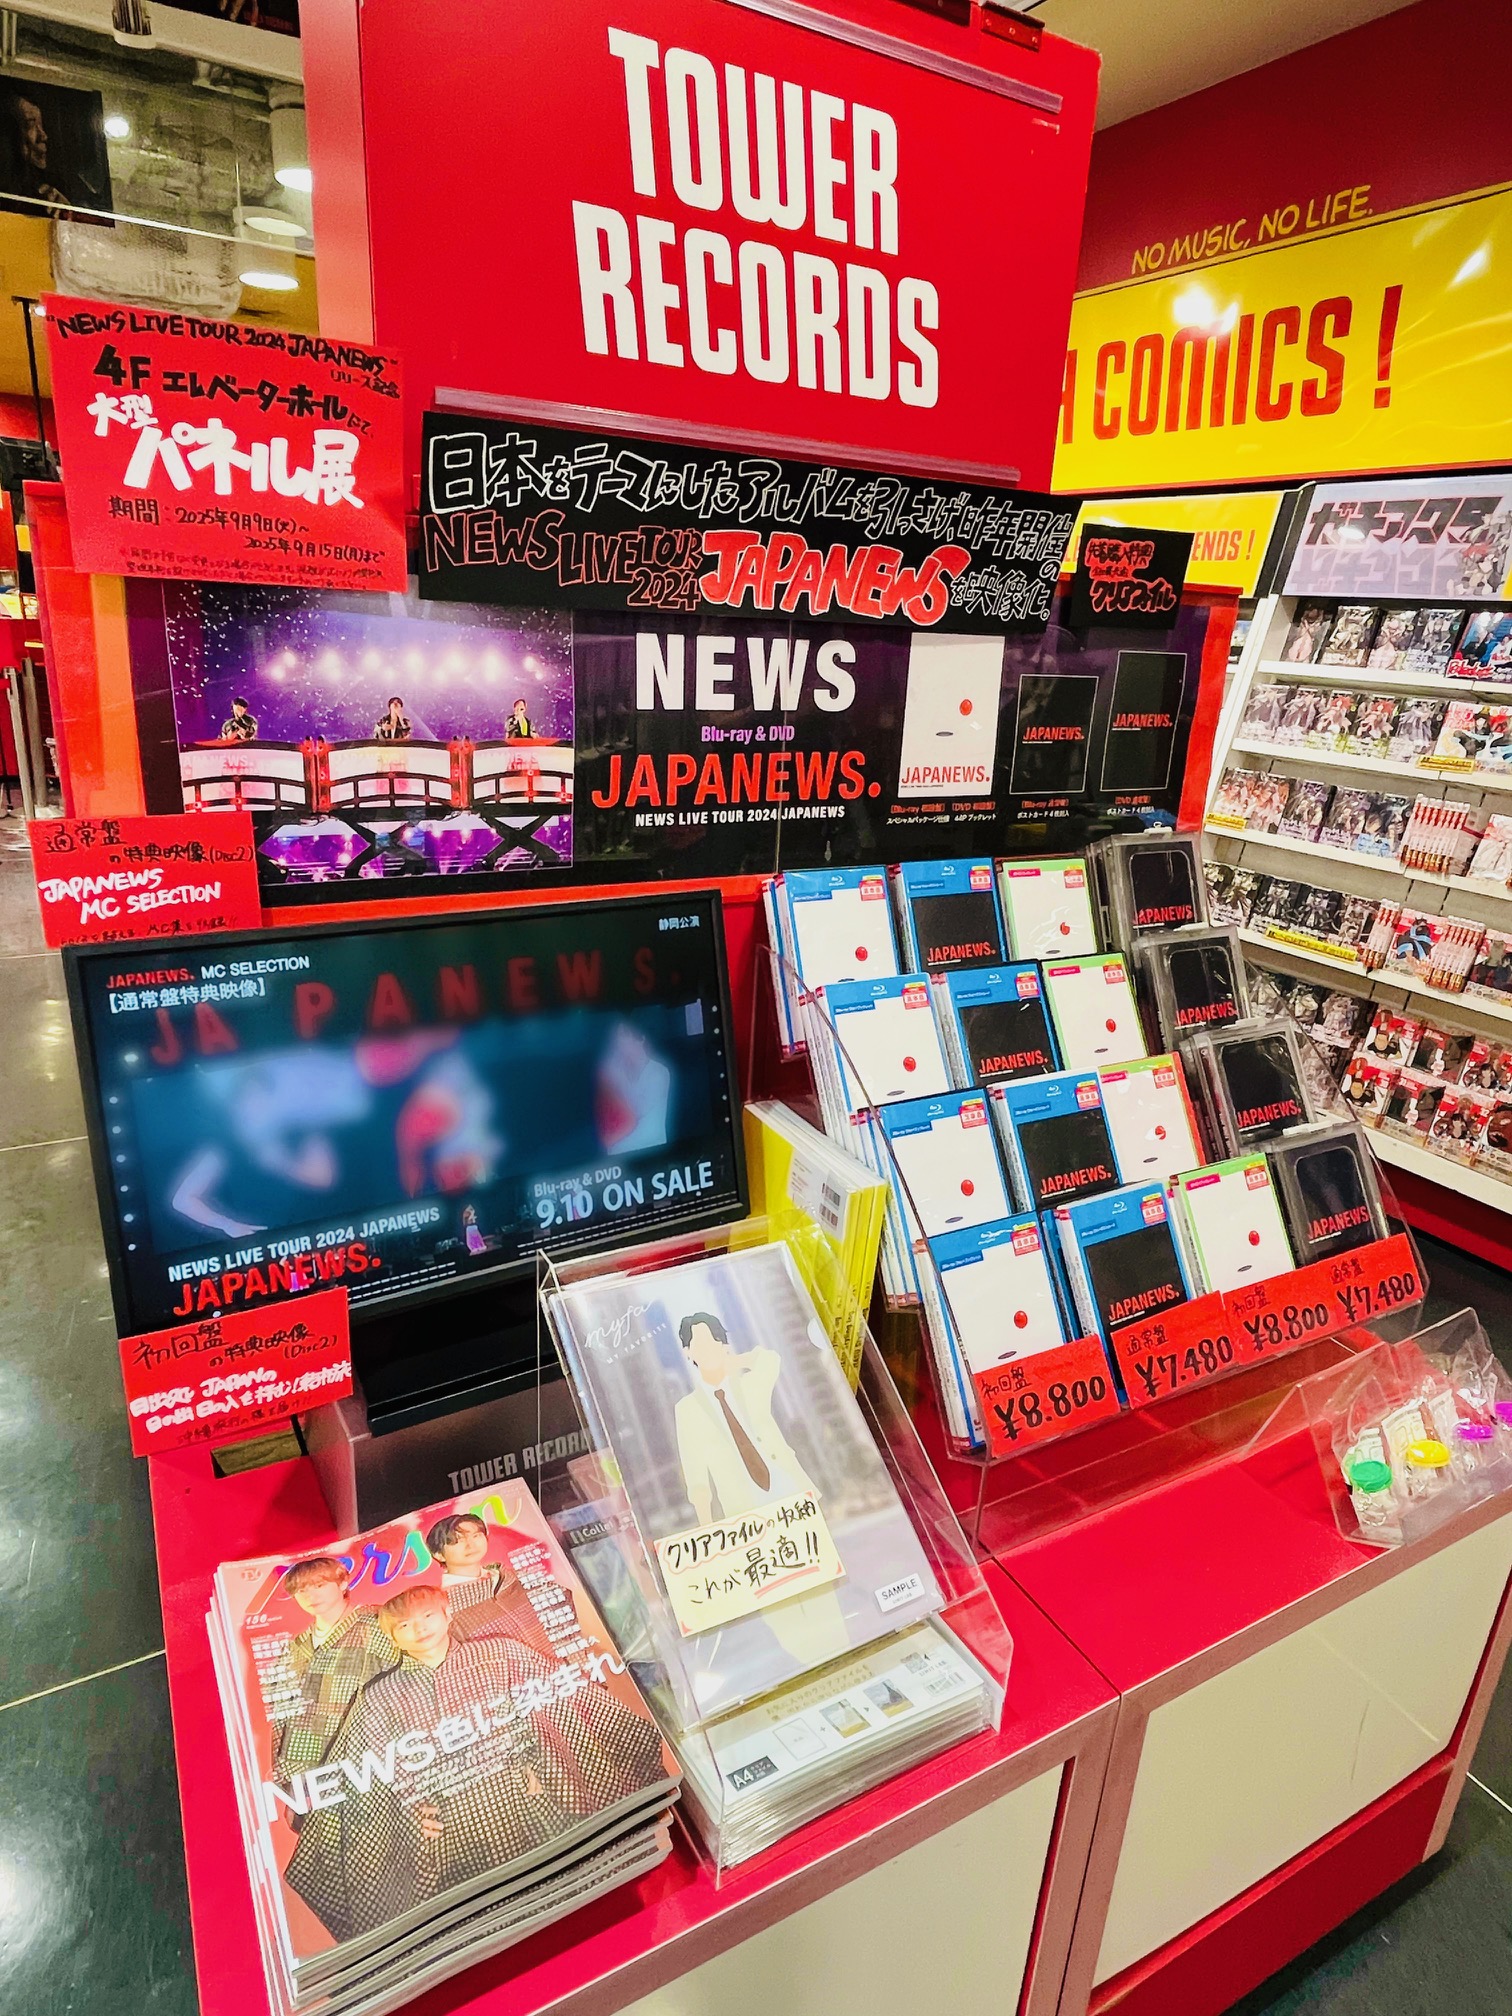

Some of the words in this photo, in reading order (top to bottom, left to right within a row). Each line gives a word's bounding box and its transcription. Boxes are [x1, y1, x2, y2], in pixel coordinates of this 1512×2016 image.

[607, 26, 899, 257] TOWER
[1131, 248, 1164, 275] NO
[1166, 218, 1251, 266] MUSIC,
[1258, 205, 1300, 241] NO
[1304, 184, 1373, 229] LIFE.
[571, 200, 940, 409] RECORDS
[130, 313, 184, 336] LIVE
[186, 317, 244, 347] TOUR
[244, 327, 287, 351] 2024
[93, 344, 152, 390] 4F
[86, 392, 159, 437] 大型
[122, 417, 365, 509] パネル展
[423, 509, 566, 573] NEWS
[558, 532, 638, 587] LIVE
[636, 525, 704, 571] TOUR
[626, 568, 702, 611] 2024
[635, 632, 857, 713] NEWS
[701, 725, 753, 745] Blu-ray
[755, 726, 767, 742] &
[769, 725, 795, 742] DVD
[1022, 726, 1085, 742] JAPANEWS.
[1112, 712, 1174, 728] JAPANEWS.
[591, 750, 882, 809] JAPANEWS.
[900, 764, 991, 785] JAPANEWS.
[44, 819, 127, 853] 通常盤
[635, 812, 675, 828] NEWS
[678, 811, 709, 827] LIVE
[711, 809, 744, 825] TOUR
[747, 808, 778, 823] 2024
[780, 805, 846, 821] JAPANEWS
[38, 868, 164, 904] JAPANEWS
[80, 896, 121, 925] MC
[127, 881, 222, 915] SELECTION
[105, 968, 196, 990] JAPANEWS.
[201, 964, 227, 980] MC
[229, 955, 311, 977] SELECTION
[927, 941, 997, 963] JAPANEWS.
[107, 977, 267, 1014] 【通常盤特典映像】
[978, 1049, 1049, 1075] JAPANEWS.
[534, 1178, 580, 1198] Blu-ray
[582, 1173, 593, 1187] &
[595, 1166, 622, 1183] DVD
[536, 1190, 594, 1230] 9.10
[602, 1177, 645, 1212] ON
[652, 1161, 714, 1201] SALE
[1039, 1164, 1113, 1196] JAPANEWS.
[168, 1256, 221, 1283] NEWS
[225, 1246, 265, 1270] LIVE
[267, 1235, 313, 1259] TOUR
[316, 1226, 356, 1249] 2024
[359, 1206, 441, 1238] JAPANEWS
[172, 1241, 383, 1318] JAPANEWS.
[1108, 1283, 1181, 1323] JAPANEWS.
[132, 1321, 230, 1371] 初回盤
[447, 1452, 519, 1495] TOWER
[522, 1427, 601, 1470] RECORD
[667, 1498, 818, 1570] クリアファイルの収納
[881, 1578, 918, 1601] SAMPLE
[733, 1768, 755, 1789] A4
